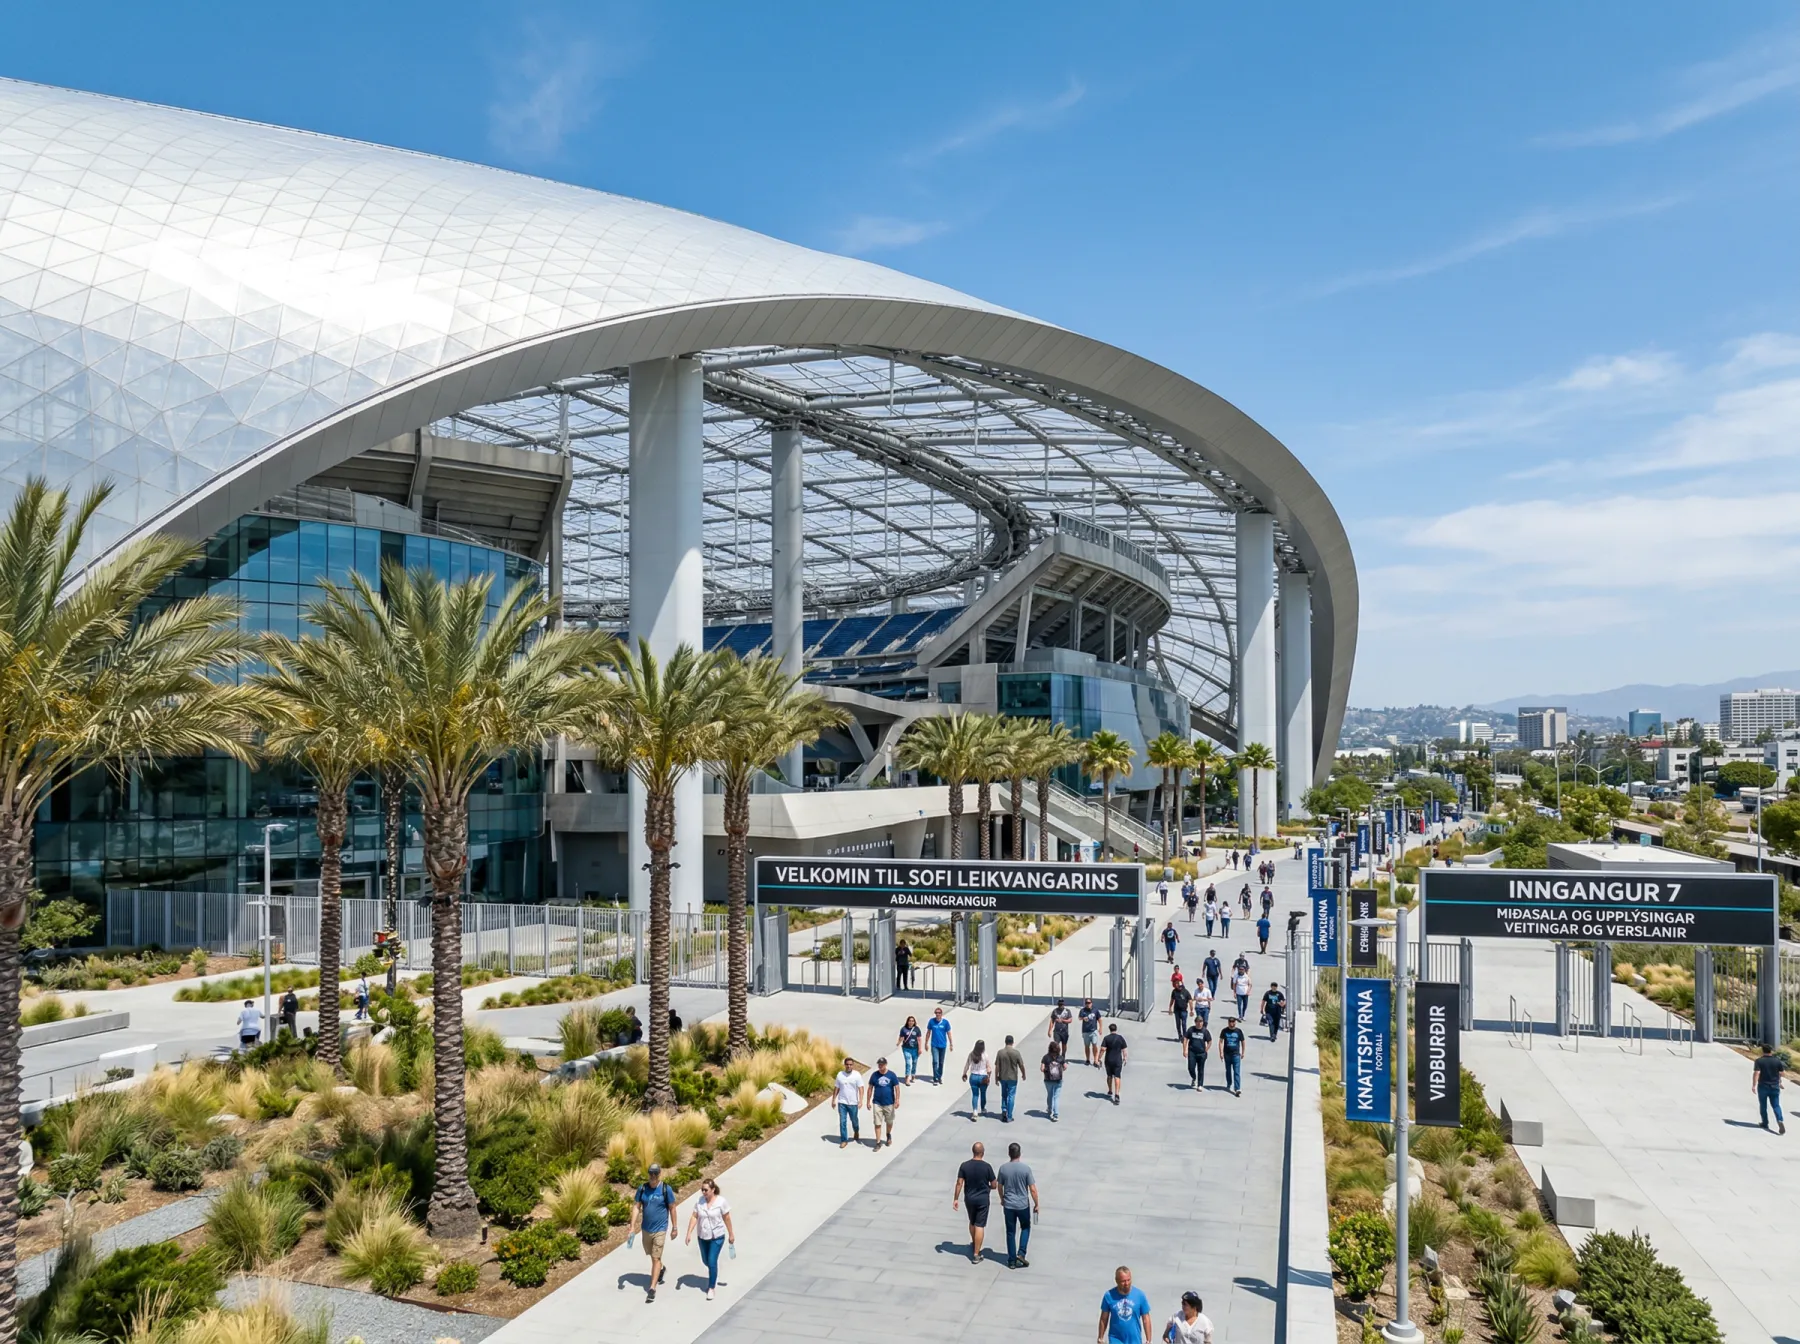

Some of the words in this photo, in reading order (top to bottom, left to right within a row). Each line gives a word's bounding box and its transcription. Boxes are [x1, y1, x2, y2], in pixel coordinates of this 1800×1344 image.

[775, 866, 870, 885] VELKOMIN
[874, 868, 904, 886] TIL
[908, 869, 952, 887] SOFI
[957, 870, 1119, 891] LEIKVANGARINS
[890, 894, 997, 908] AÐALINNGRANGUR
[1509, 880, 1660, 902] INNGANGUR
[1666, 883, 1682, 903] 7
[1496, 908, 1569, 921] MIÐASALA
[1571, 910, 1593, 922] OG
[1595, 909, 1695, 925] UPPLÝSINGAR
[1504, 922, 1579, 935] VEITINGAR
[1582, 924, 1603, 936] OG
[1606, 924, 1687, 939] VERSLANIR
[1357, 989, 1373, 1110] KNATTSPYRNA
[1429, 1005, 1446, 1101] VIÐBURÐIR
